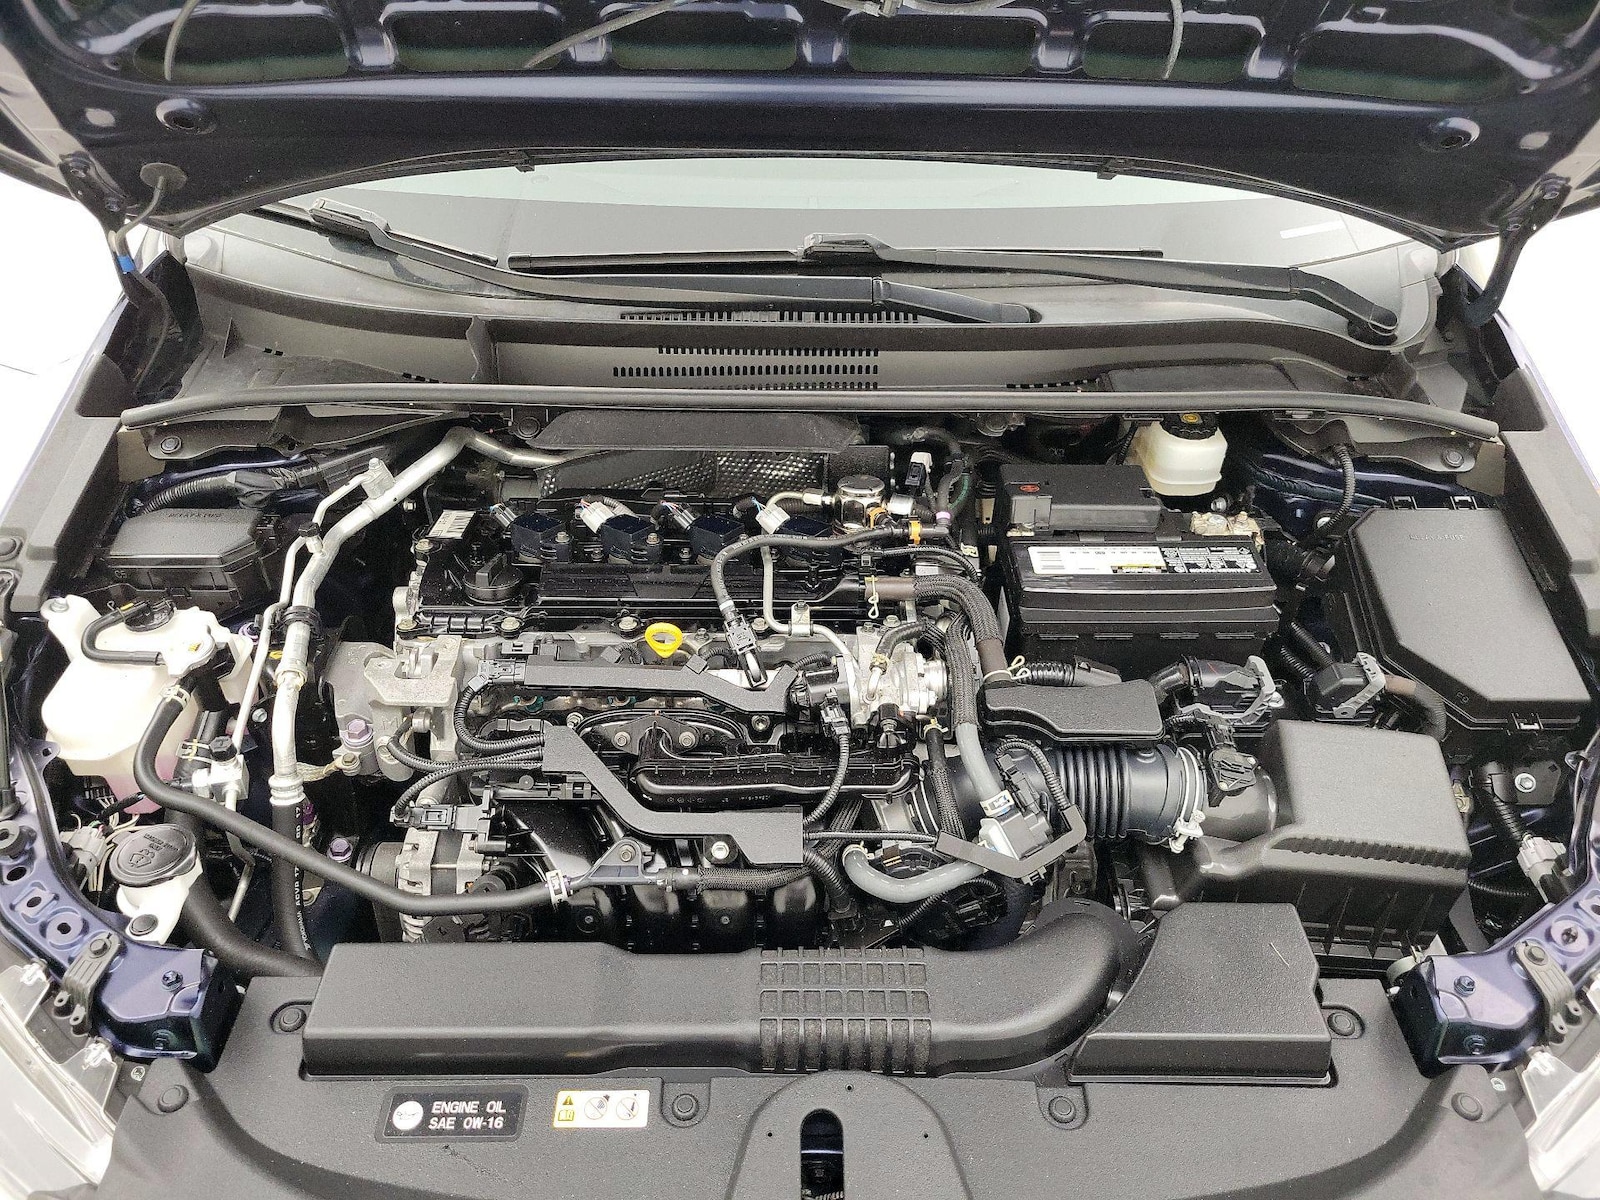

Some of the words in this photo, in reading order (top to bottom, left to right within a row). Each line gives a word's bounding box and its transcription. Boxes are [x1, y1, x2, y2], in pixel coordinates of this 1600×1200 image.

[431, 1100, 480, 1114] ENGINE
[485, 1100, 507, 1114] OIL
[428, 1116, 457, 1130] SAE
[462, 1116, 504, 1130] 0W-16
